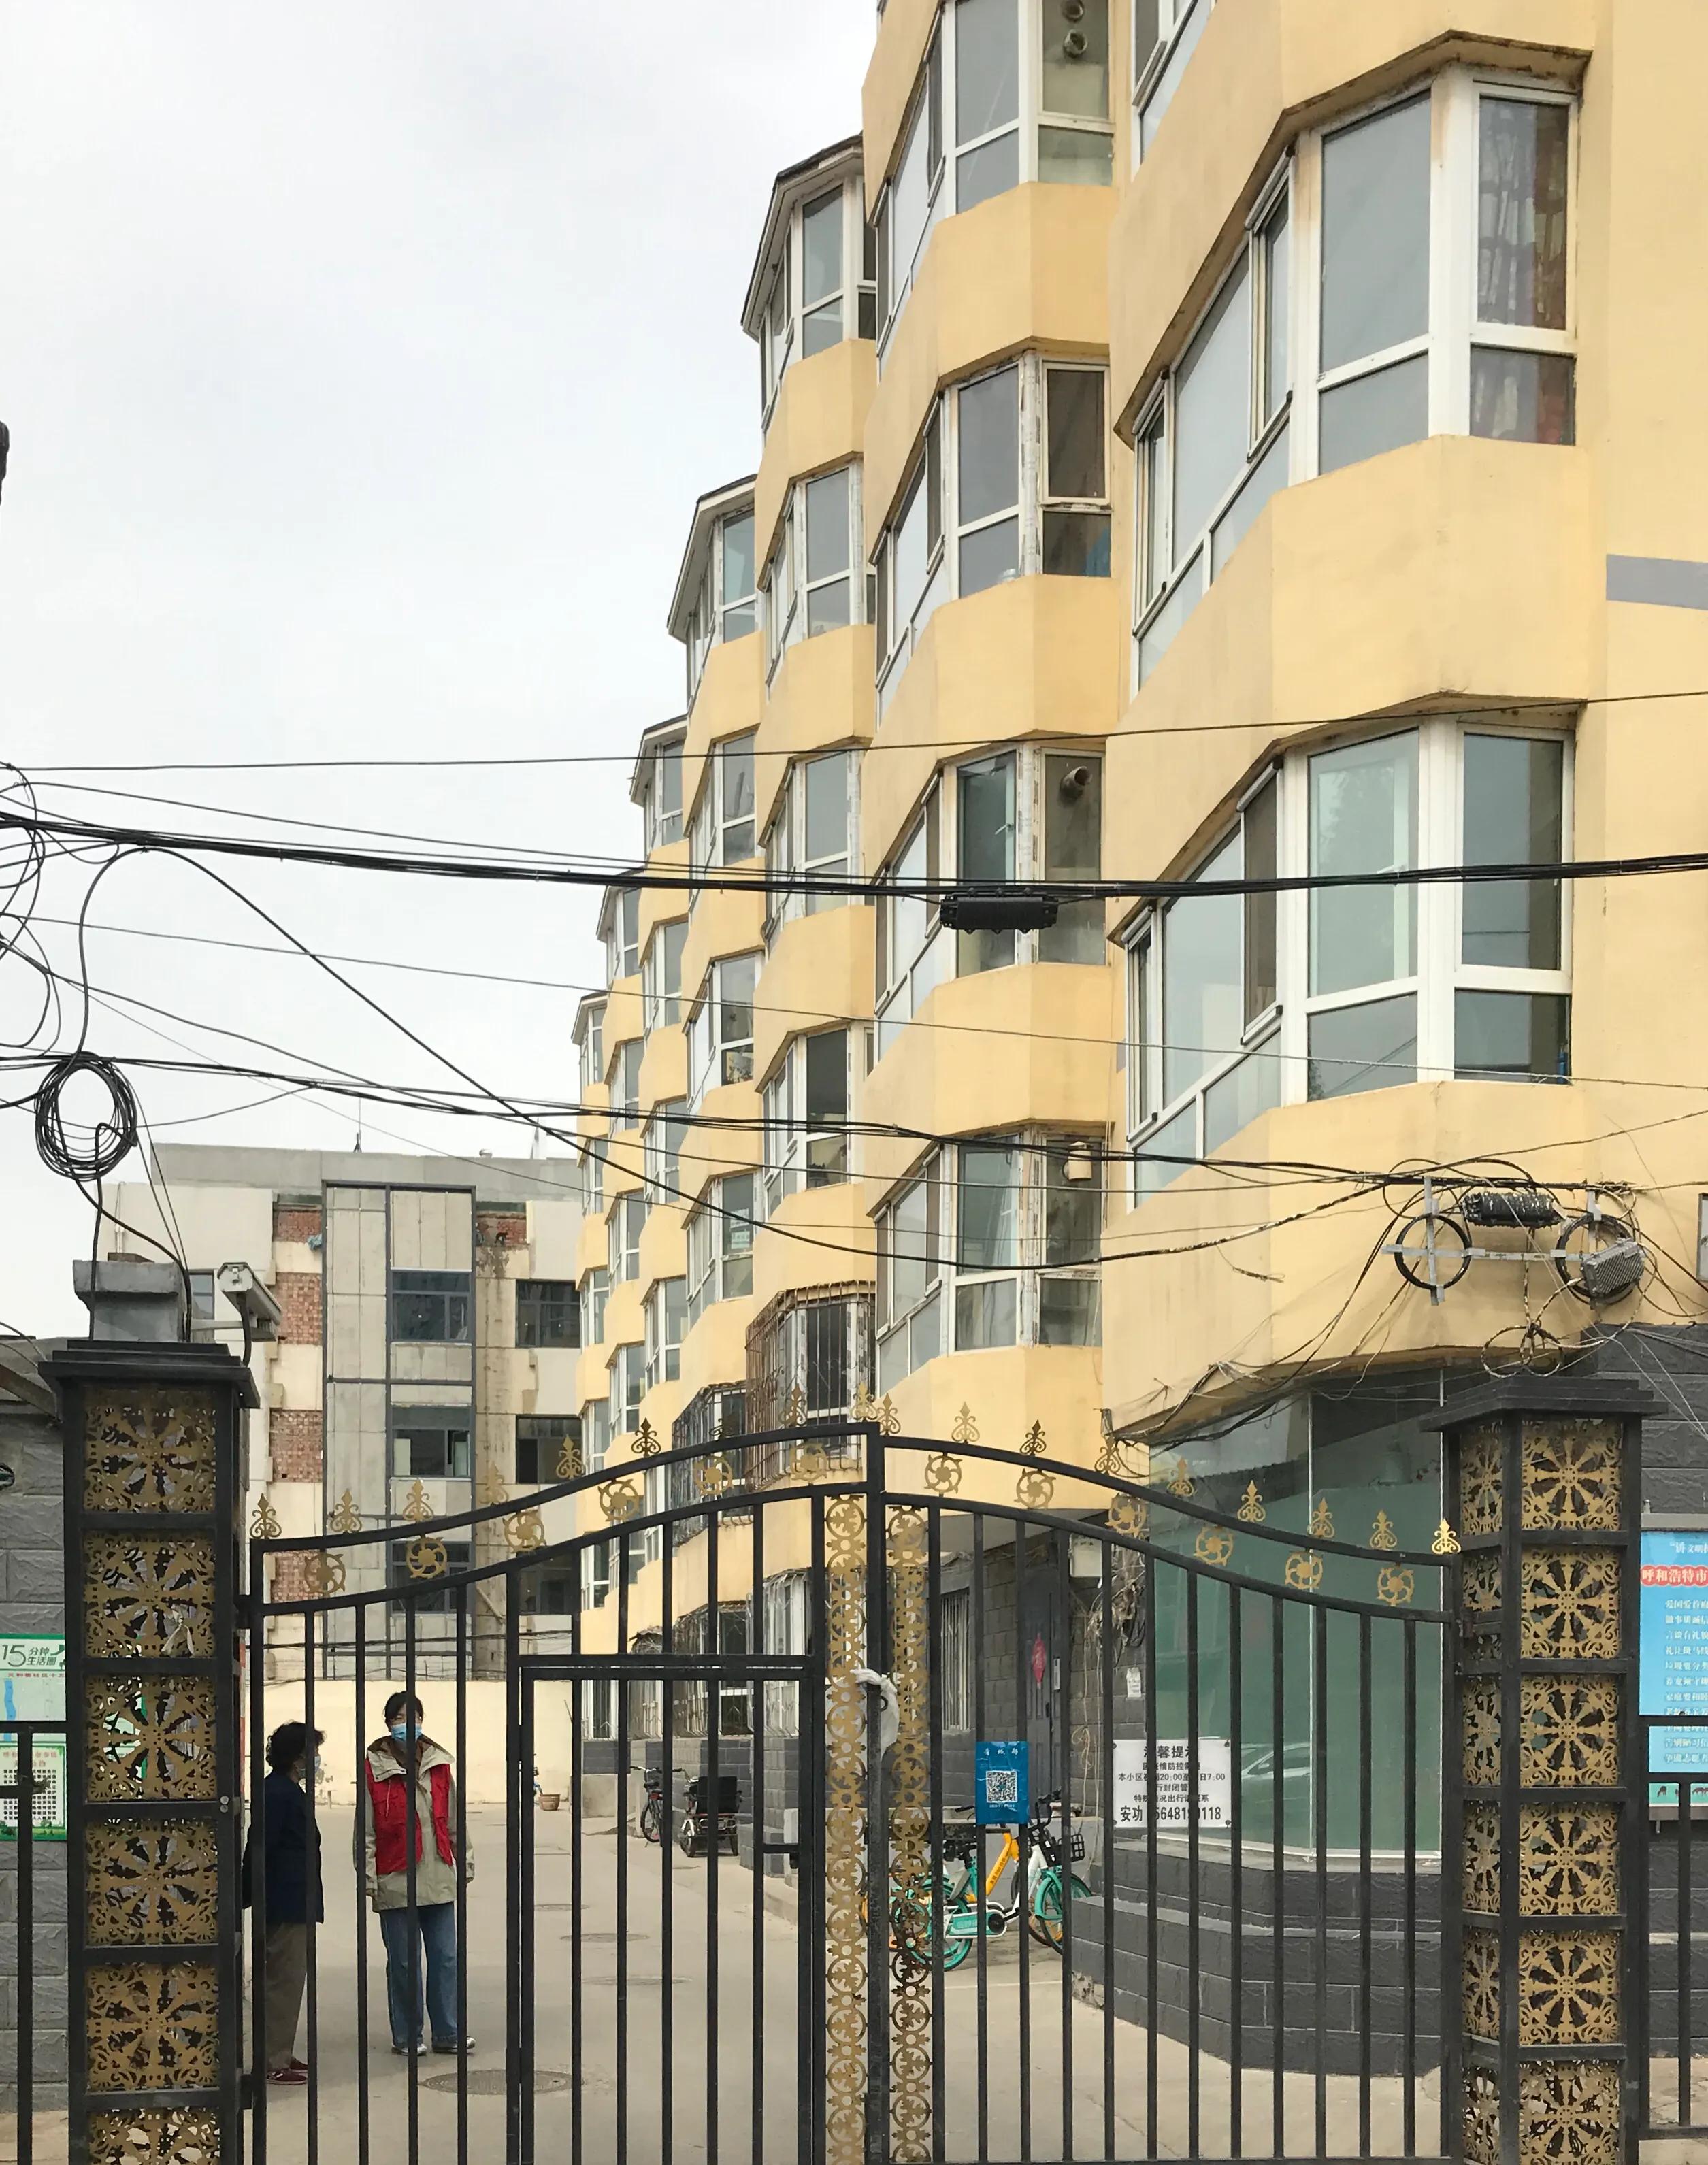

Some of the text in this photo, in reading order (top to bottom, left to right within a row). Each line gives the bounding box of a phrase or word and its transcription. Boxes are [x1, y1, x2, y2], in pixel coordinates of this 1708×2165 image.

[1641, 1568, 1708, 1583] 呼和浩特市
[2, 1644, 50, 1667] 15 分钟
[1144, 1745, 1190, 1758] 馨提
